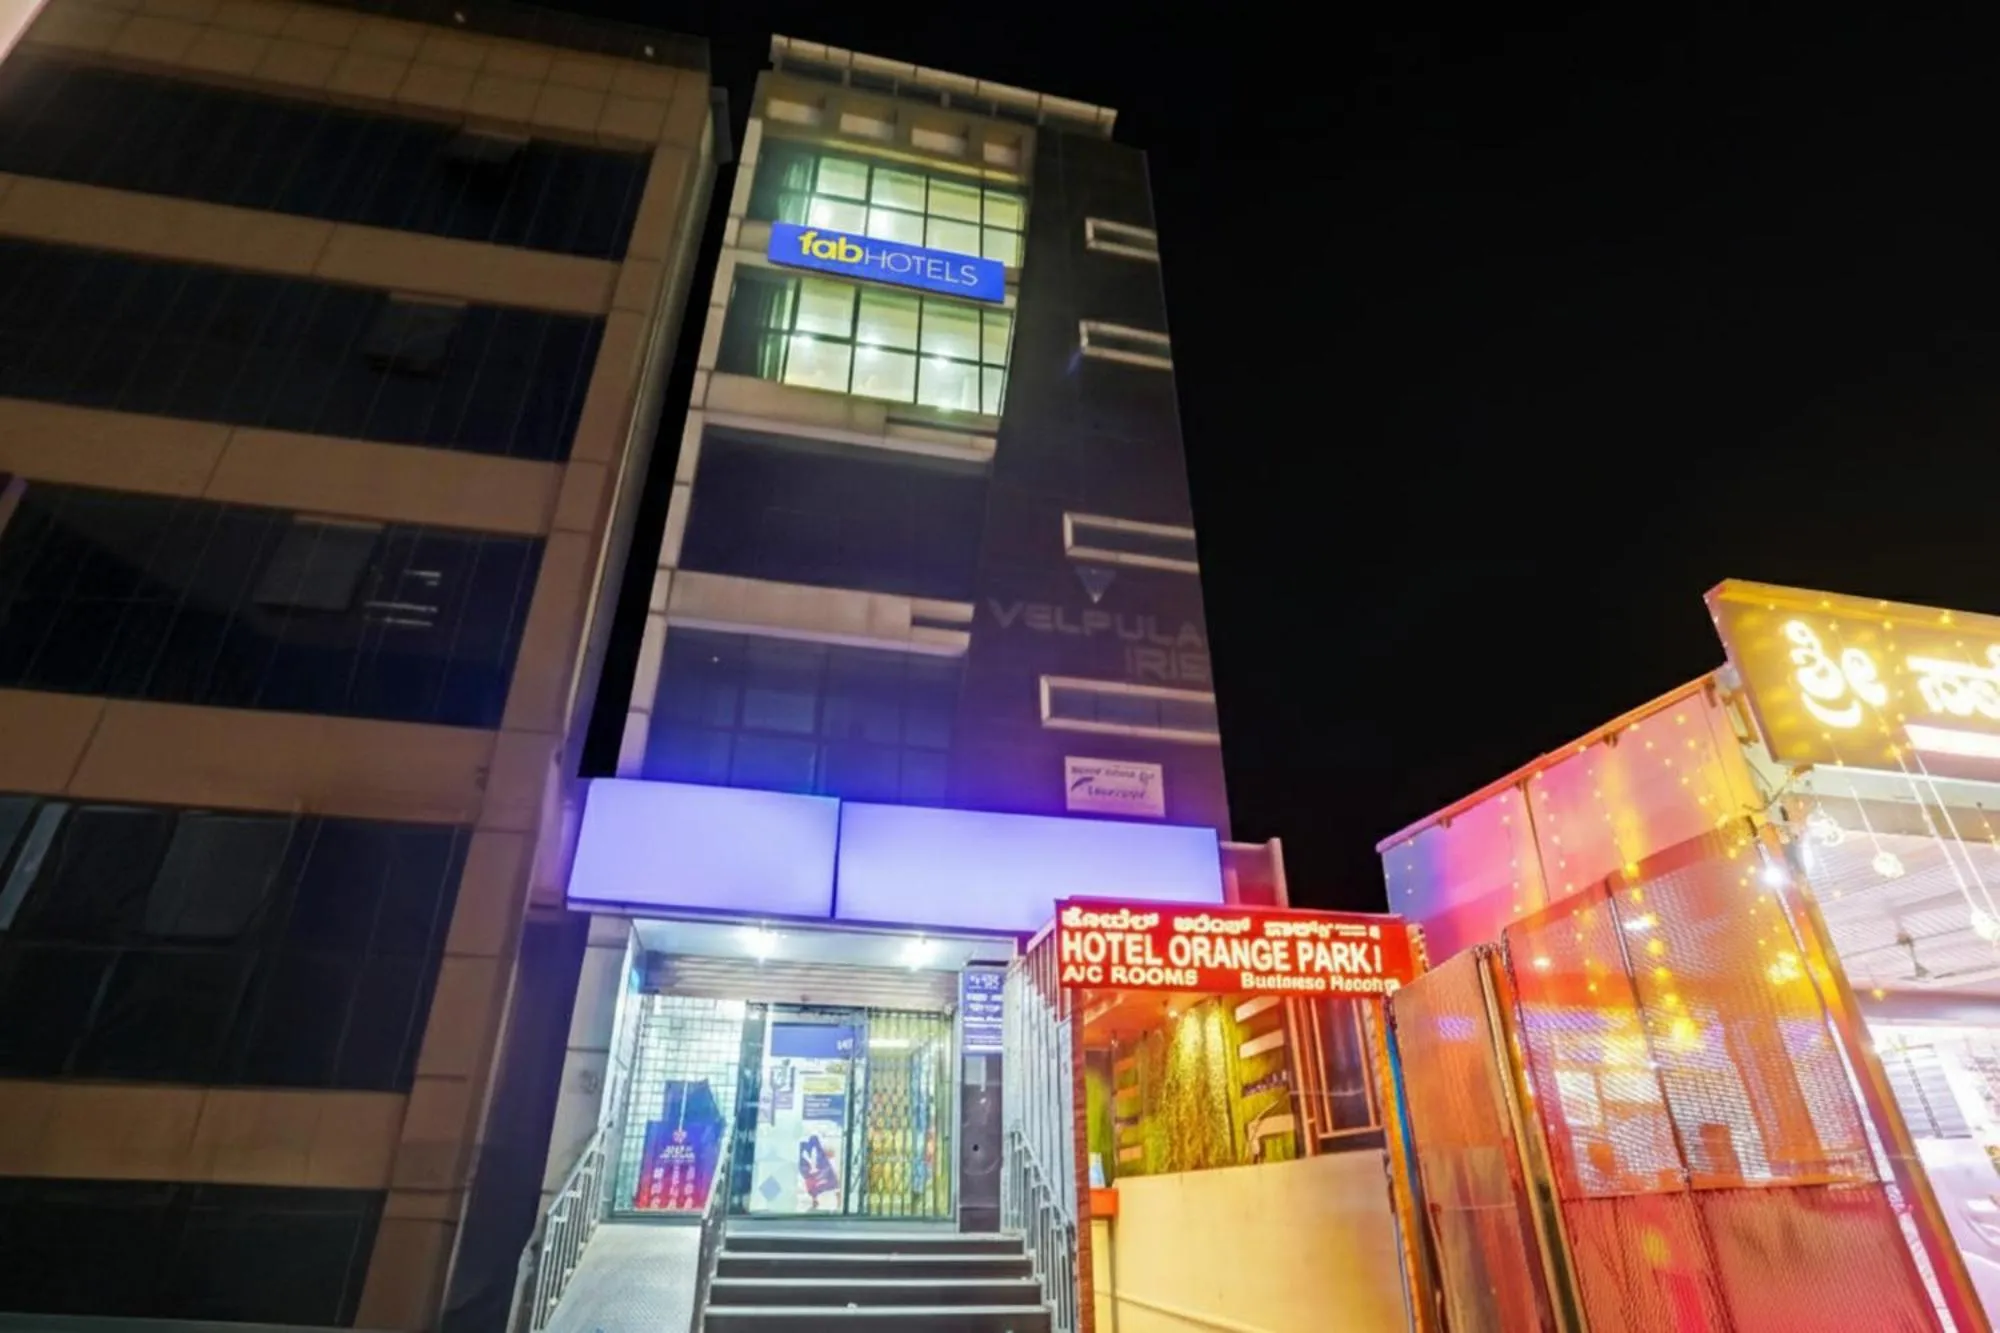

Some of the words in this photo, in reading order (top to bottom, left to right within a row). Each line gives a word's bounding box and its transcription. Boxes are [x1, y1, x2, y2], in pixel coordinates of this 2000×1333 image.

[986, 596, 1203, 648] VELPULA
[1061, 929, 1164, 966] HOTEL
[1168, 934, 1292, 972] ORANGE
[1295, 939, 1373, 974] PARK
[1110, 965, 1199, 987] ROOMS
